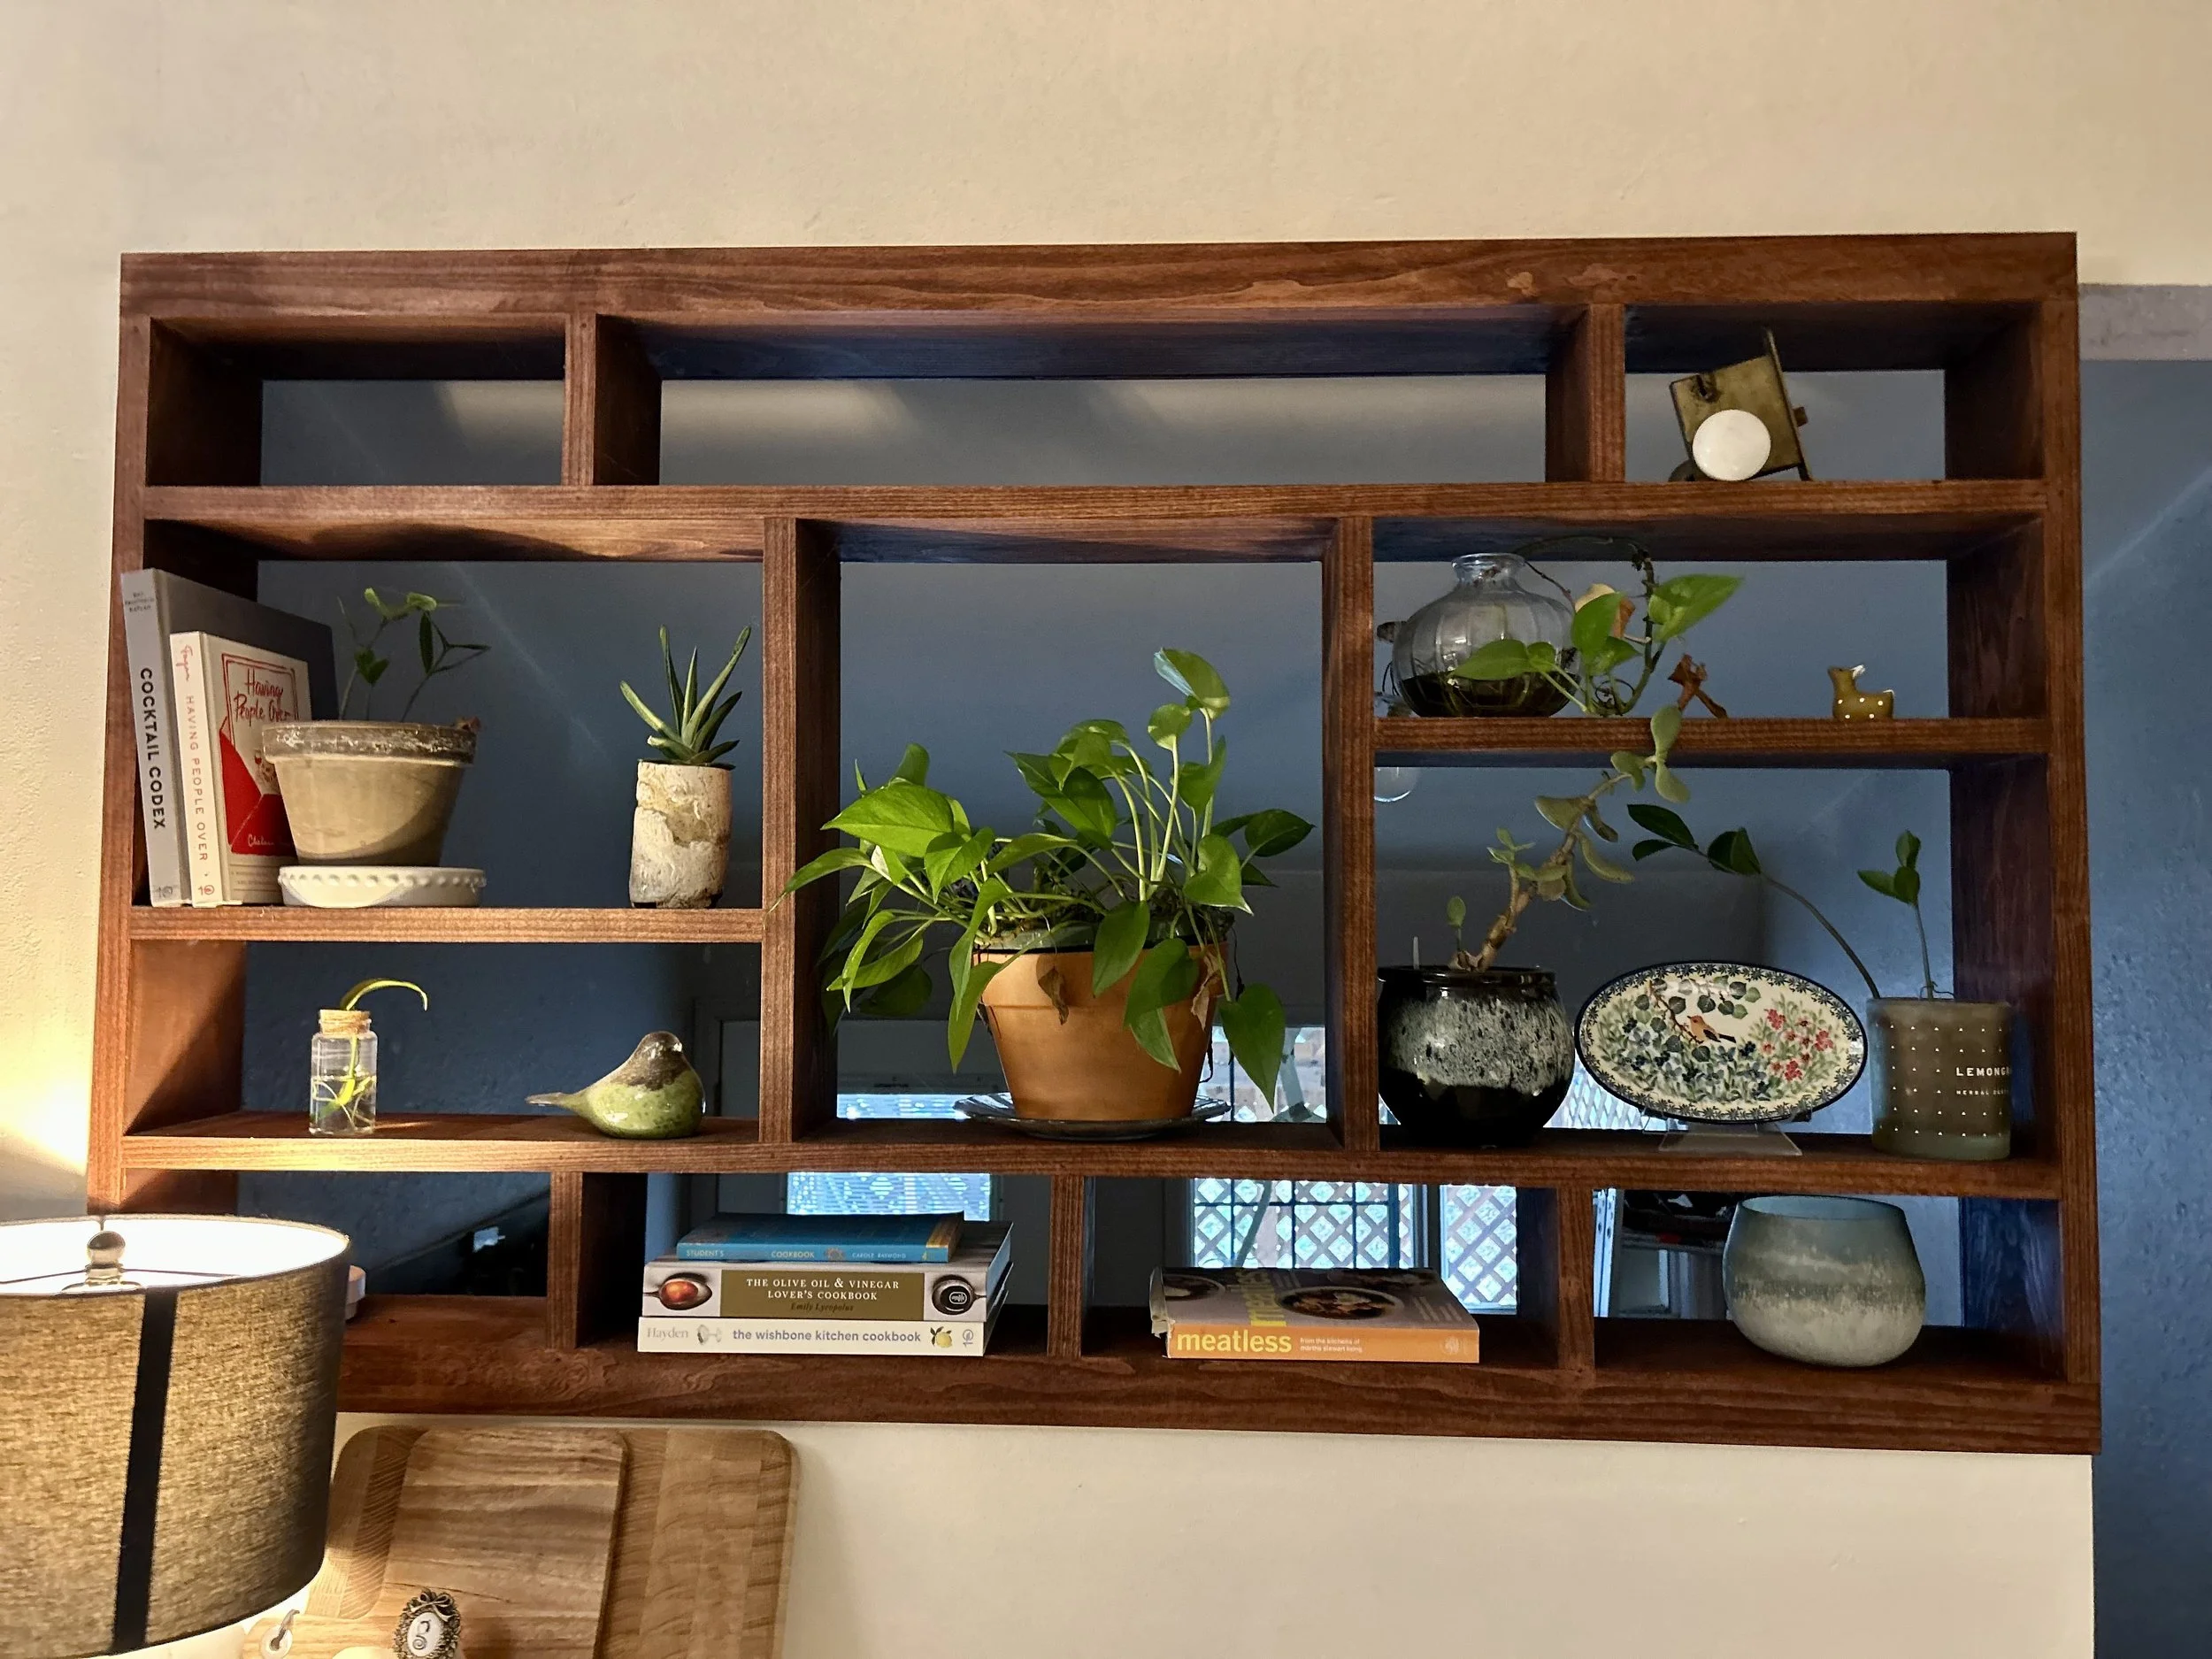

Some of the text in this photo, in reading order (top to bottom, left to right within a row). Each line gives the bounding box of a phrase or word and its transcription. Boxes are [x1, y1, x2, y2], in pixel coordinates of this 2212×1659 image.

[245, 668, 284, 703] Having
[234, 690, 265, 726] People
[140, 667, 165, 829] COCKTAIL CODEX
[186, 695, 208, 861] HAVING PEOPLE OVER
[746, 1277, 900, 1289] THE OLIVE OIL & VINEGAR
[767, 1290, 878, 1301] LOVER'S COOKBOOK
[646, 1327, 688, 1341] Hayden
[733, 1329, 921, 1342] the wishbone kitchen cookbook
[1177, 1329, 1292, 1353] meatless
